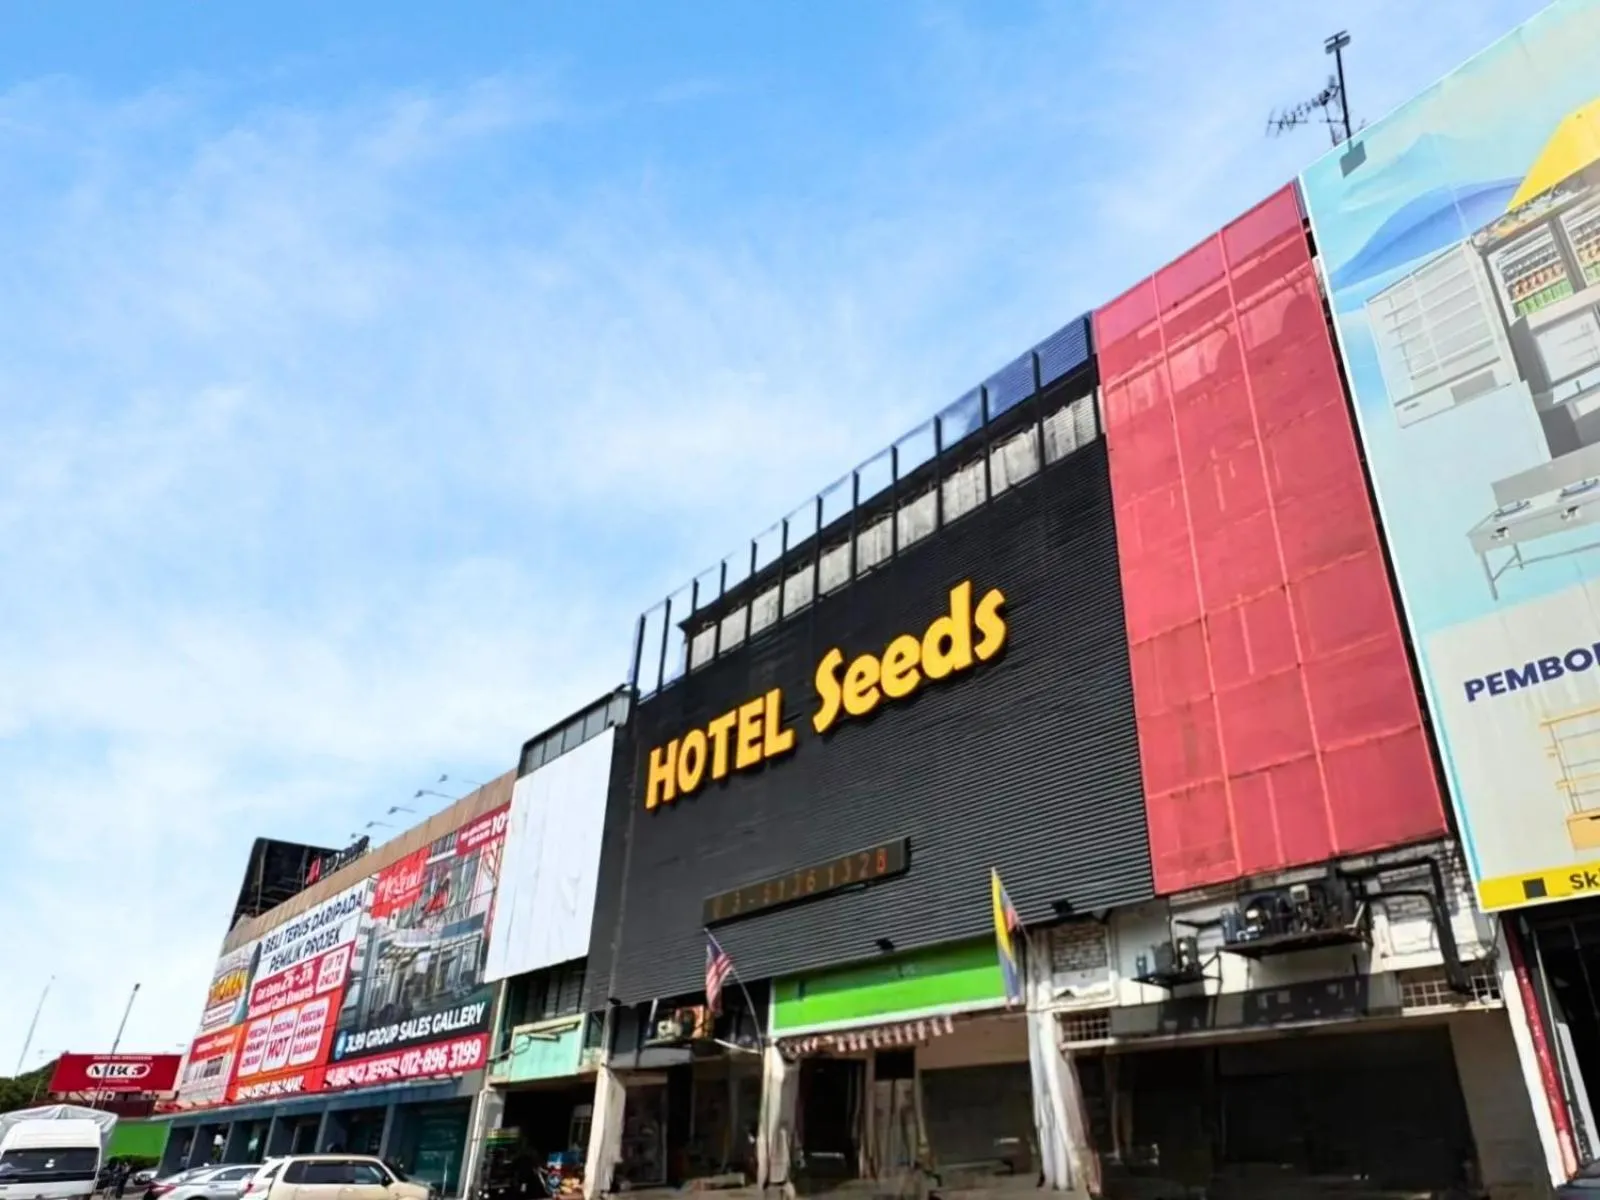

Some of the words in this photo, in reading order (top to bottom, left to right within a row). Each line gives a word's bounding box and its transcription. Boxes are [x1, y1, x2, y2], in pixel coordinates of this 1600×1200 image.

[645, 687, 795, 809] HOTEL
[811, 579, 1008, 734] Seeds
[1569, 868, 1600, 890] Sk
[263, 934, 284, 955] BELI
[284, 918, 311, 944] TERUS
[311, 890, 363, 931] DARIPADA
[268, 944, 302, 974] PEMILIK
[303, 928, 341, 957] PROJEK
[366, 1023, 399, 1048] GROUP
[398, 1015, 431, 1042] SALES
[432, 1002, 486, 1034] GALLERY
[400, 1047, 448, 1075] 012-896
[447, 1038, 482, 1068] 3199
